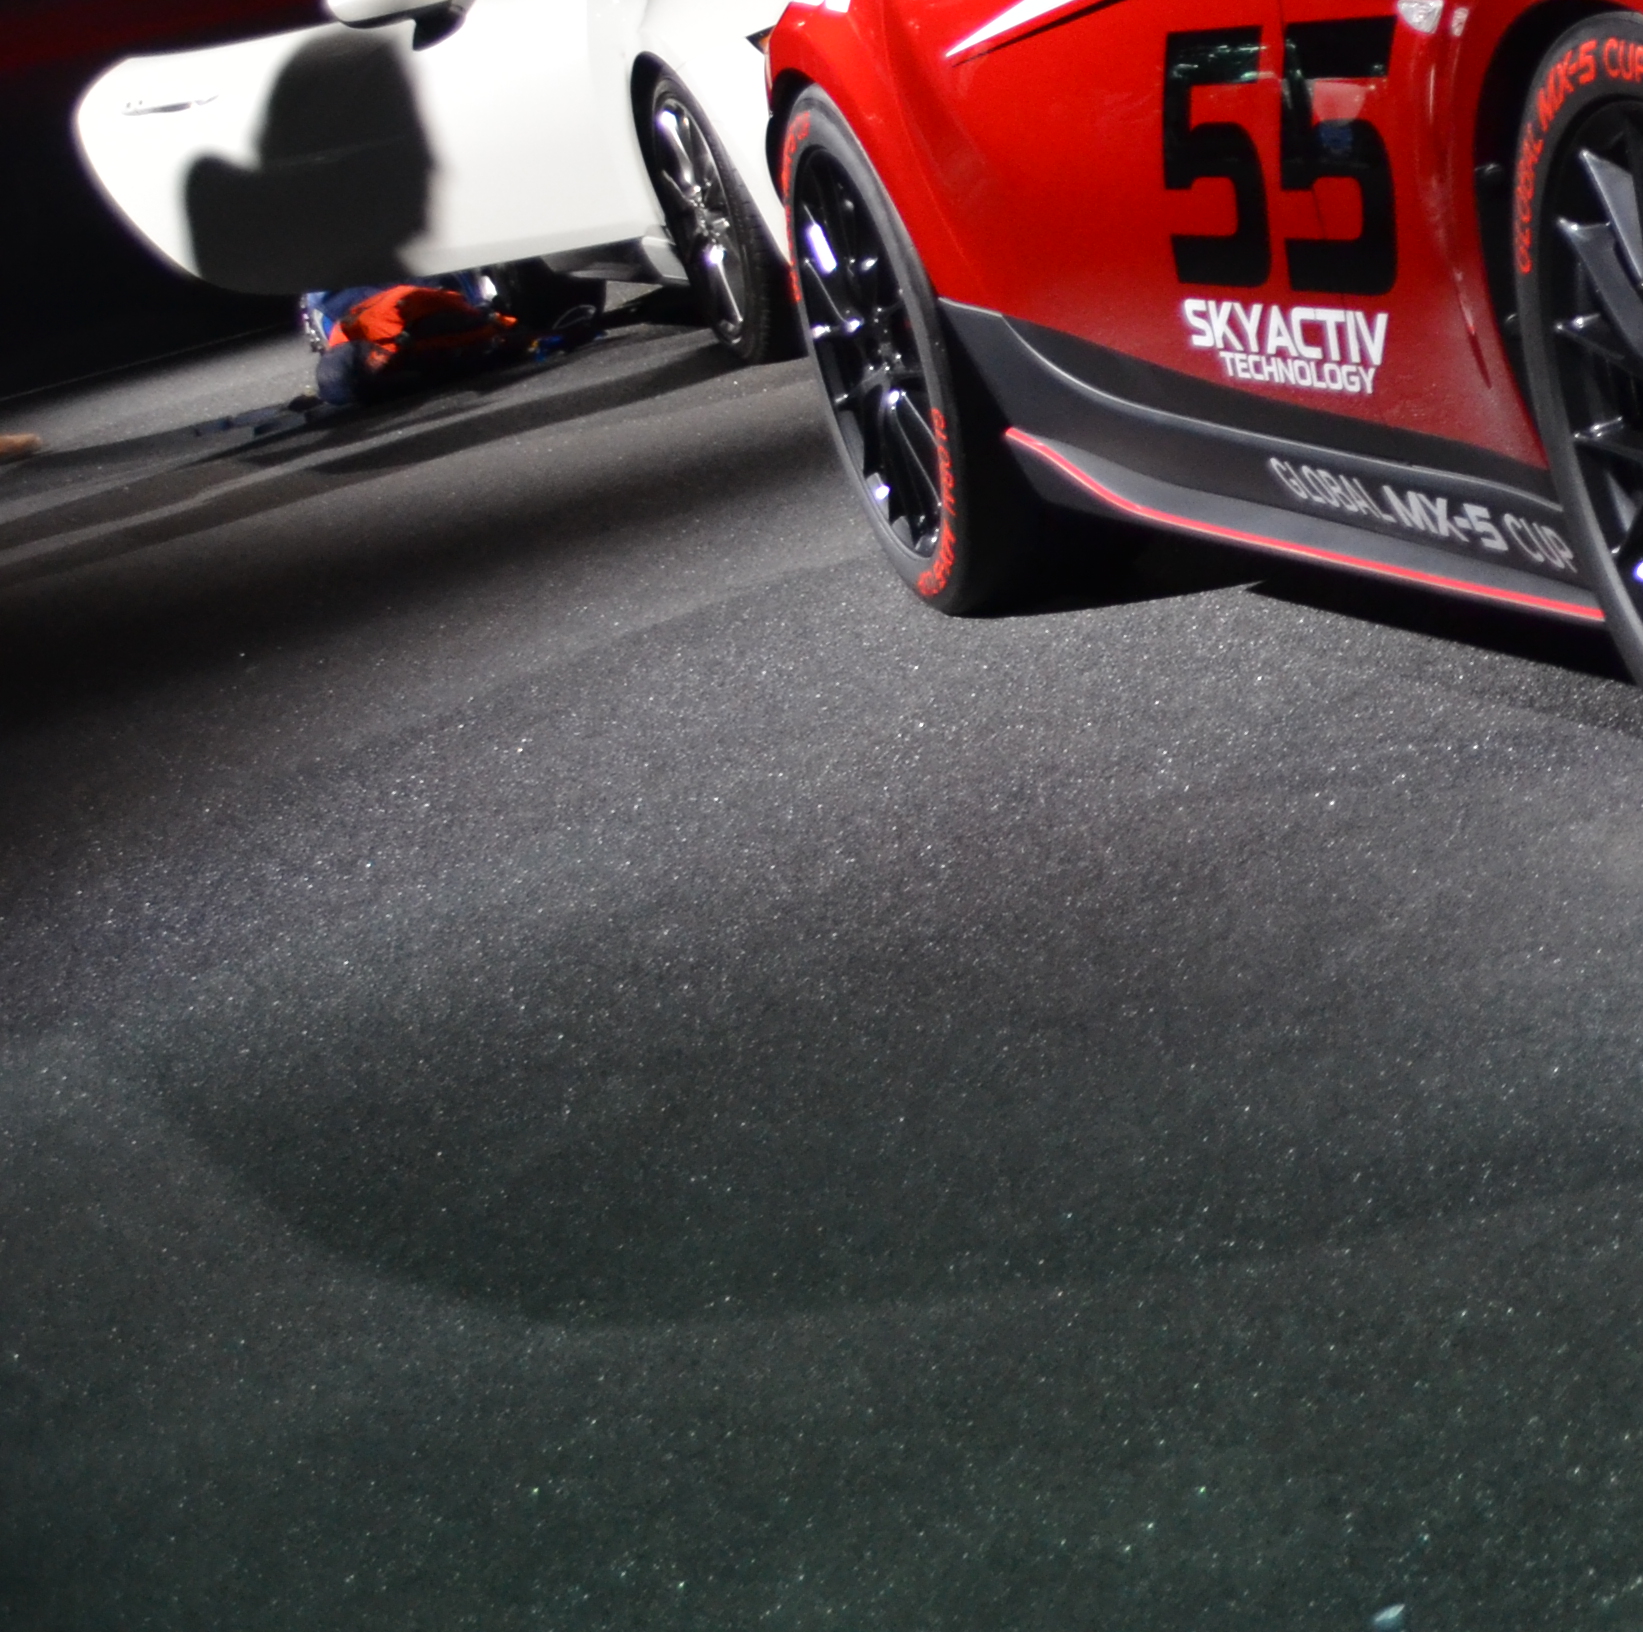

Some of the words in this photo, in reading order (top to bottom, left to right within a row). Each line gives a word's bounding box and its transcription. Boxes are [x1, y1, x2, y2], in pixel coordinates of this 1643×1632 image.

[1536, 39, 1597, 133] MX-5
[1162, 15, 1399, 296] 55
[1183, 298, 1389, 367] SKYACTIV
[1219, 350, 1377, 395] TECHNOLOGY
[1269, 456, 1396, 524] GLOBAL
[1382, 485, 1509, 552] MX-5
[1503, 513, 1578, 574] CUP
